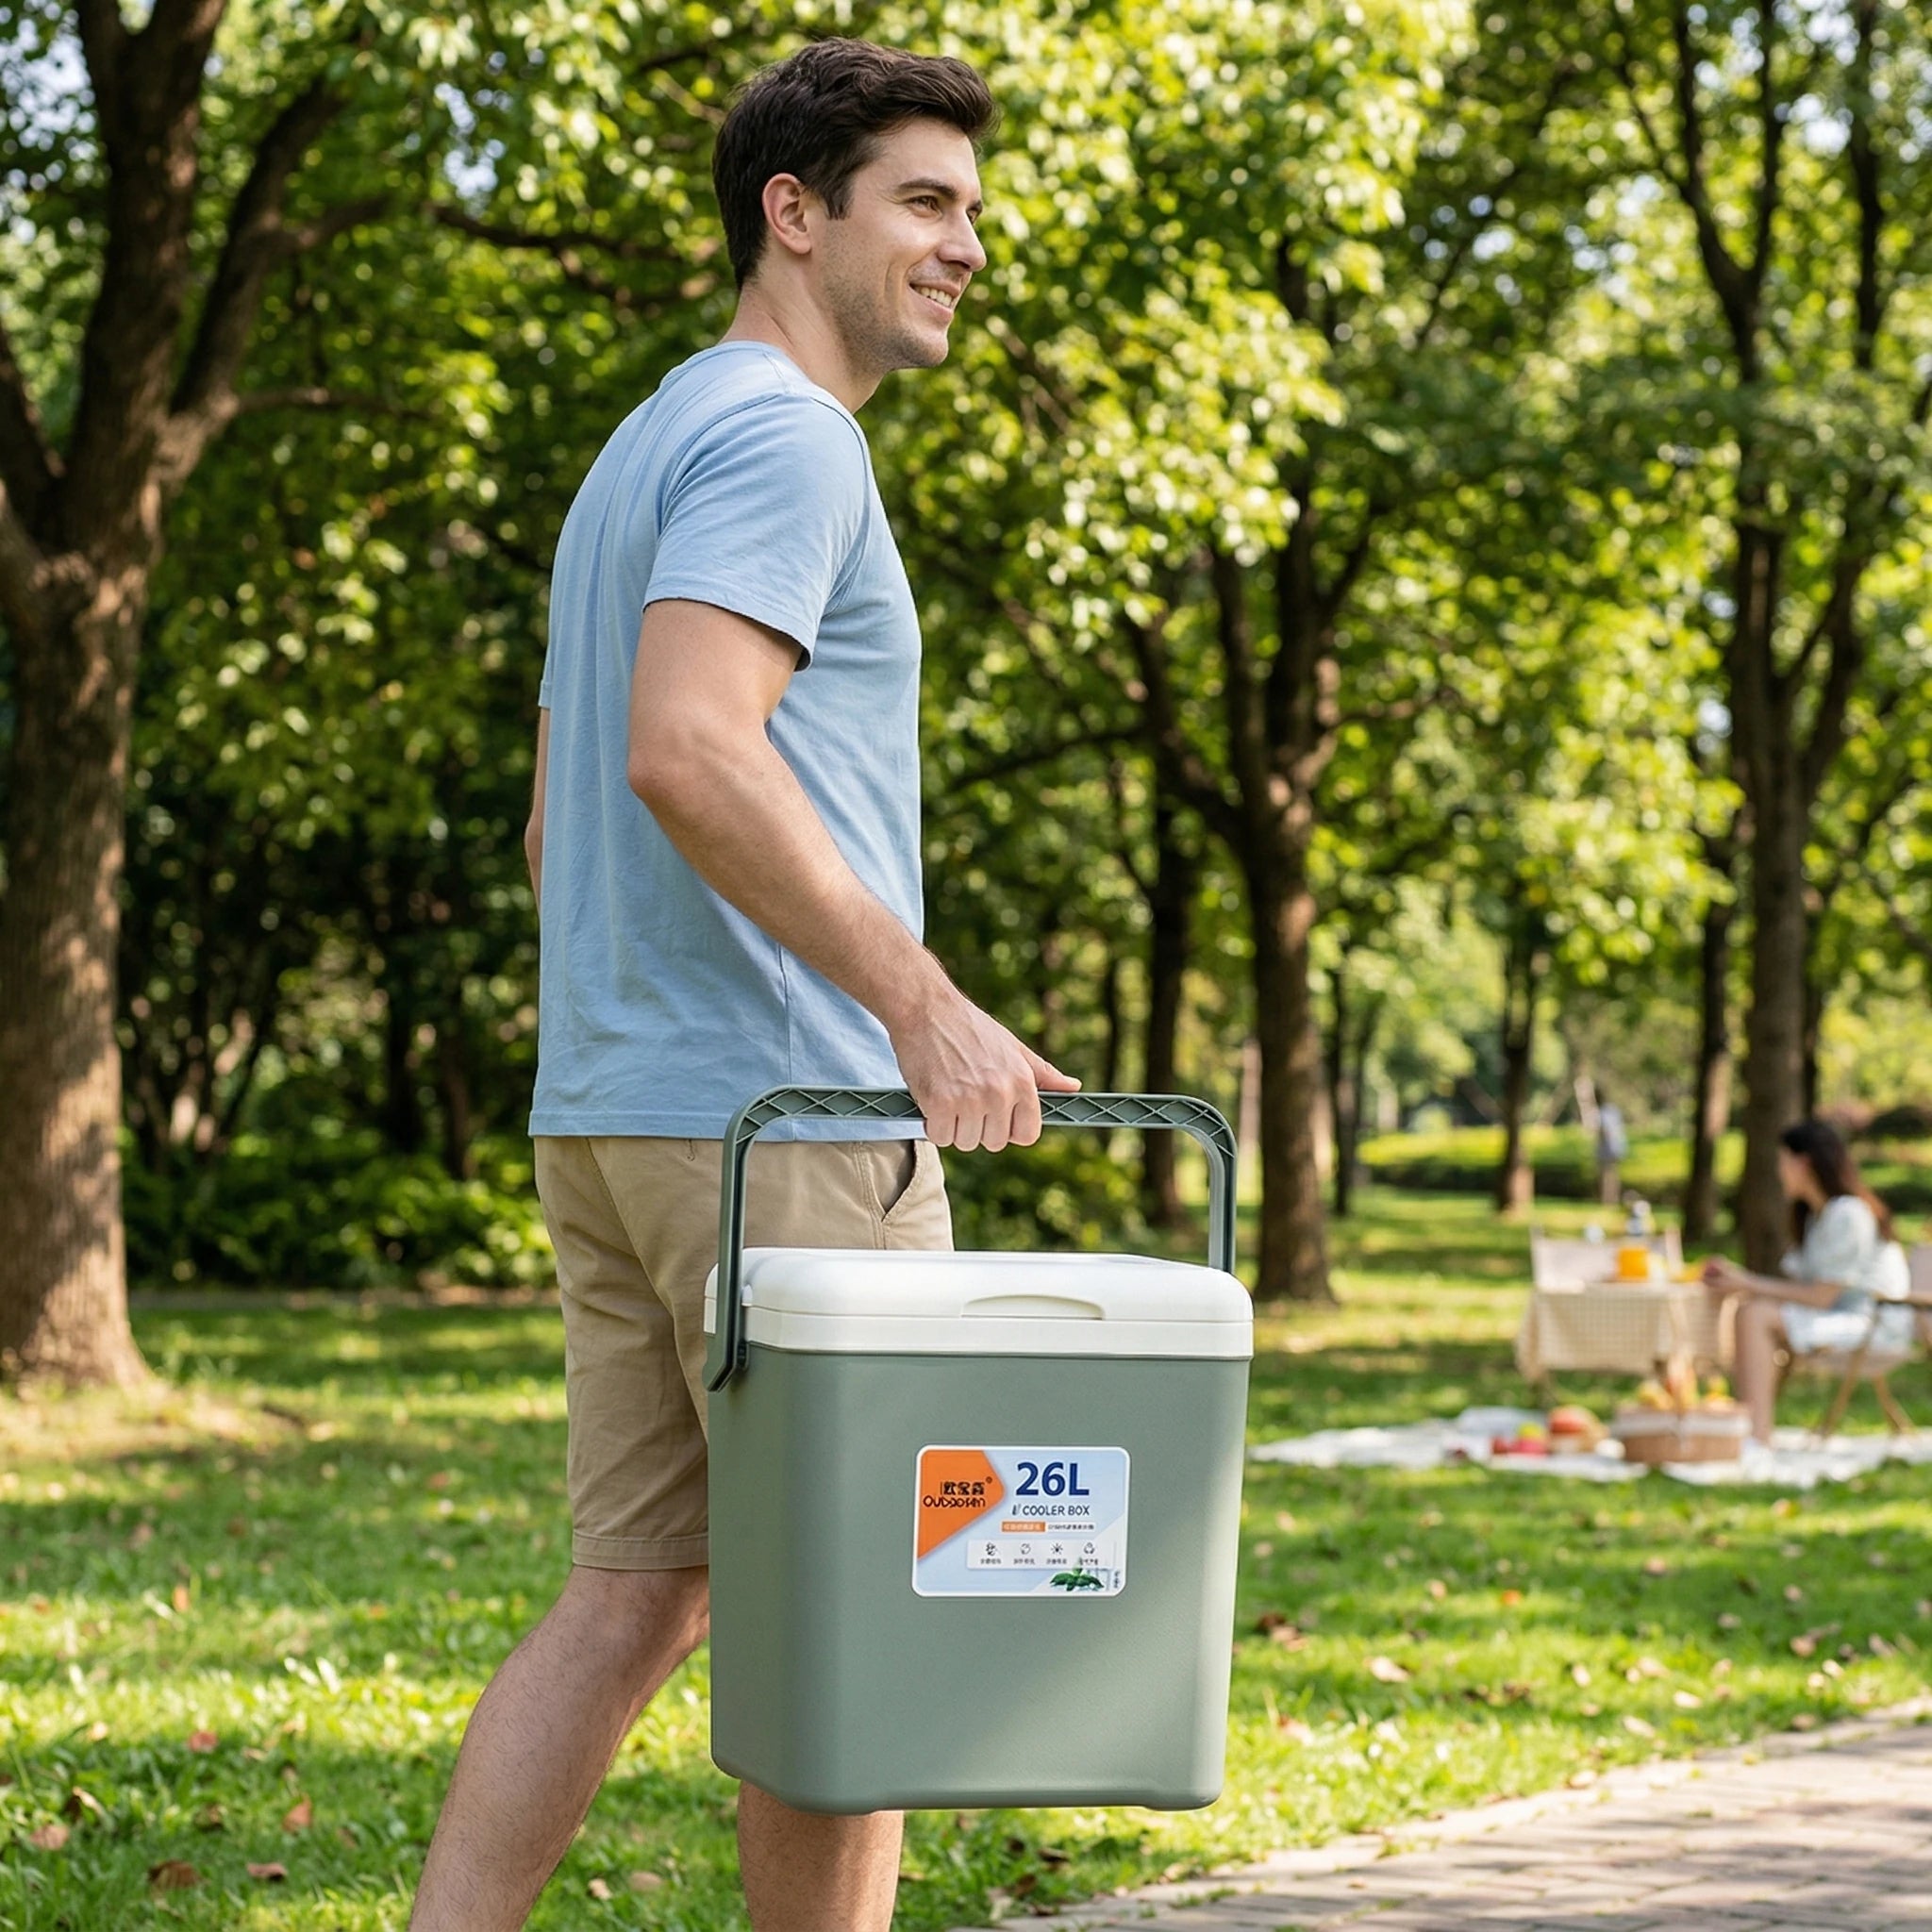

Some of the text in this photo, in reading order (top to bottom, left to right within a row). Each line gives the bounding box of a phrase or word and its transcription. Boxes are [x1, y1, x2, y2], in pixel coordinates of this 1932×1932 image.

[1015, 1461, 1090, 1496] 26L
[1023, 1505, 1090, 1516] COOLER BOX
